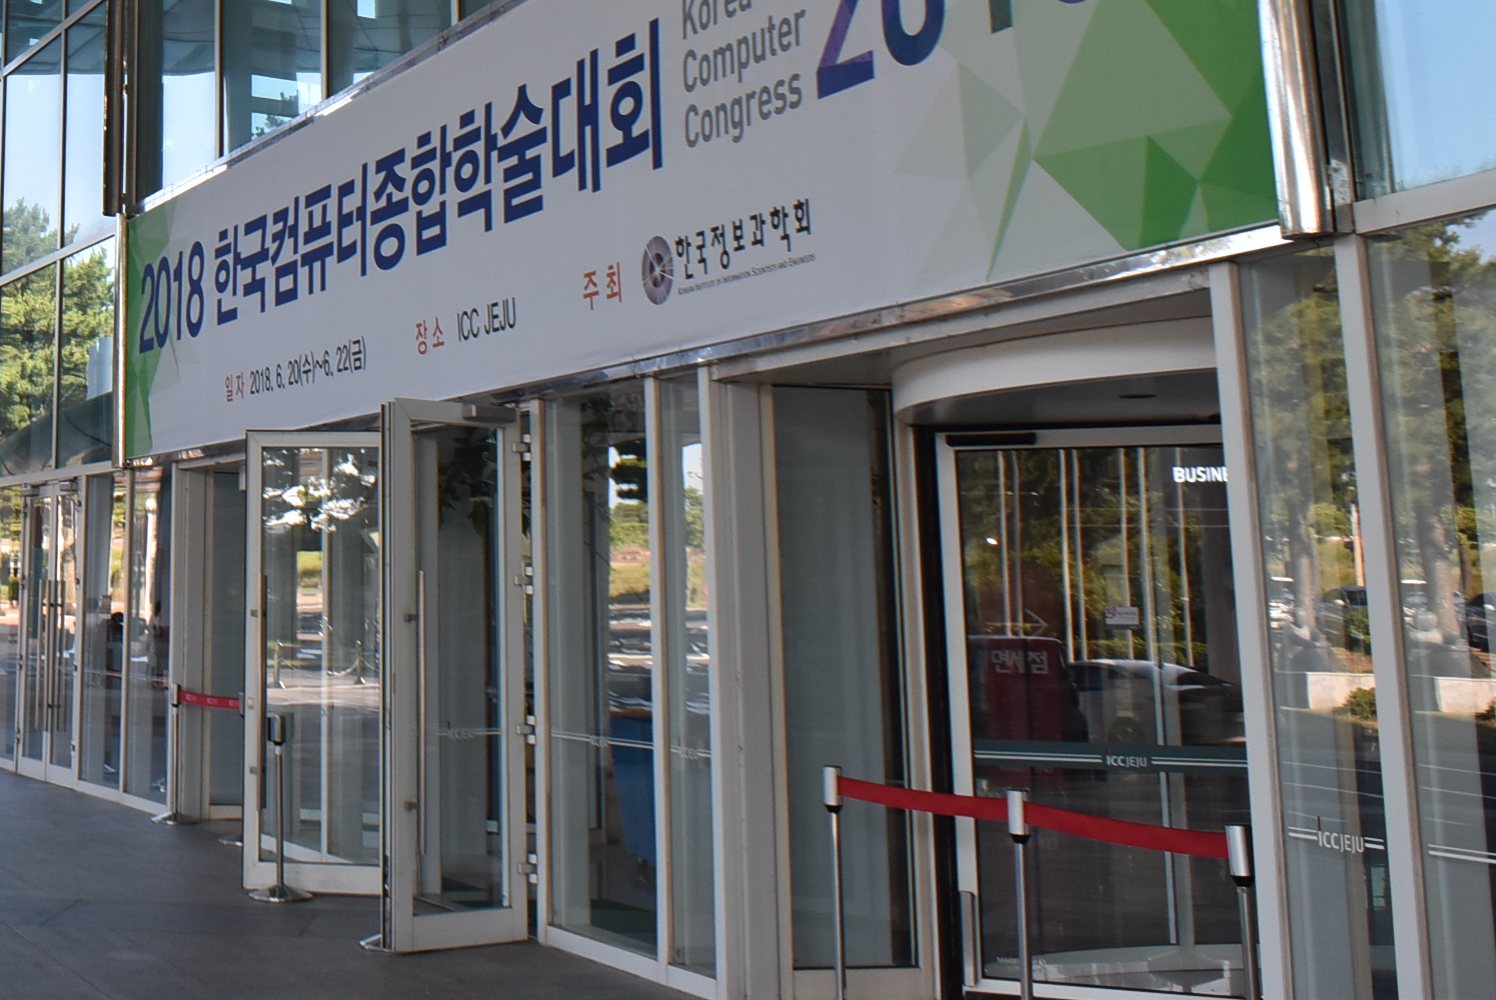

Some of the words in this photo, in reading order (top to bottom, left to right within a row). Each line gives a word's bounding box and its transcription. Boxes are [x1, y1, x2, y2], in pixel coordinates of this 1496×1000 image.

[683, 8, 807, 92] Computer
[685, 68, 803, 148] Congress
[139, 240, 205, 354] 2018
[215, 17, 664, 325] 한국컴퓨터종합학술대회
[674, 198, 812, 279] 한국정보과학회
[456, 308, 480, 341] ICC
[483, 297, 517, 335] JEJU
[249, 367, 273, 395] 2018.
[276, 364, 285, 389] 6.
